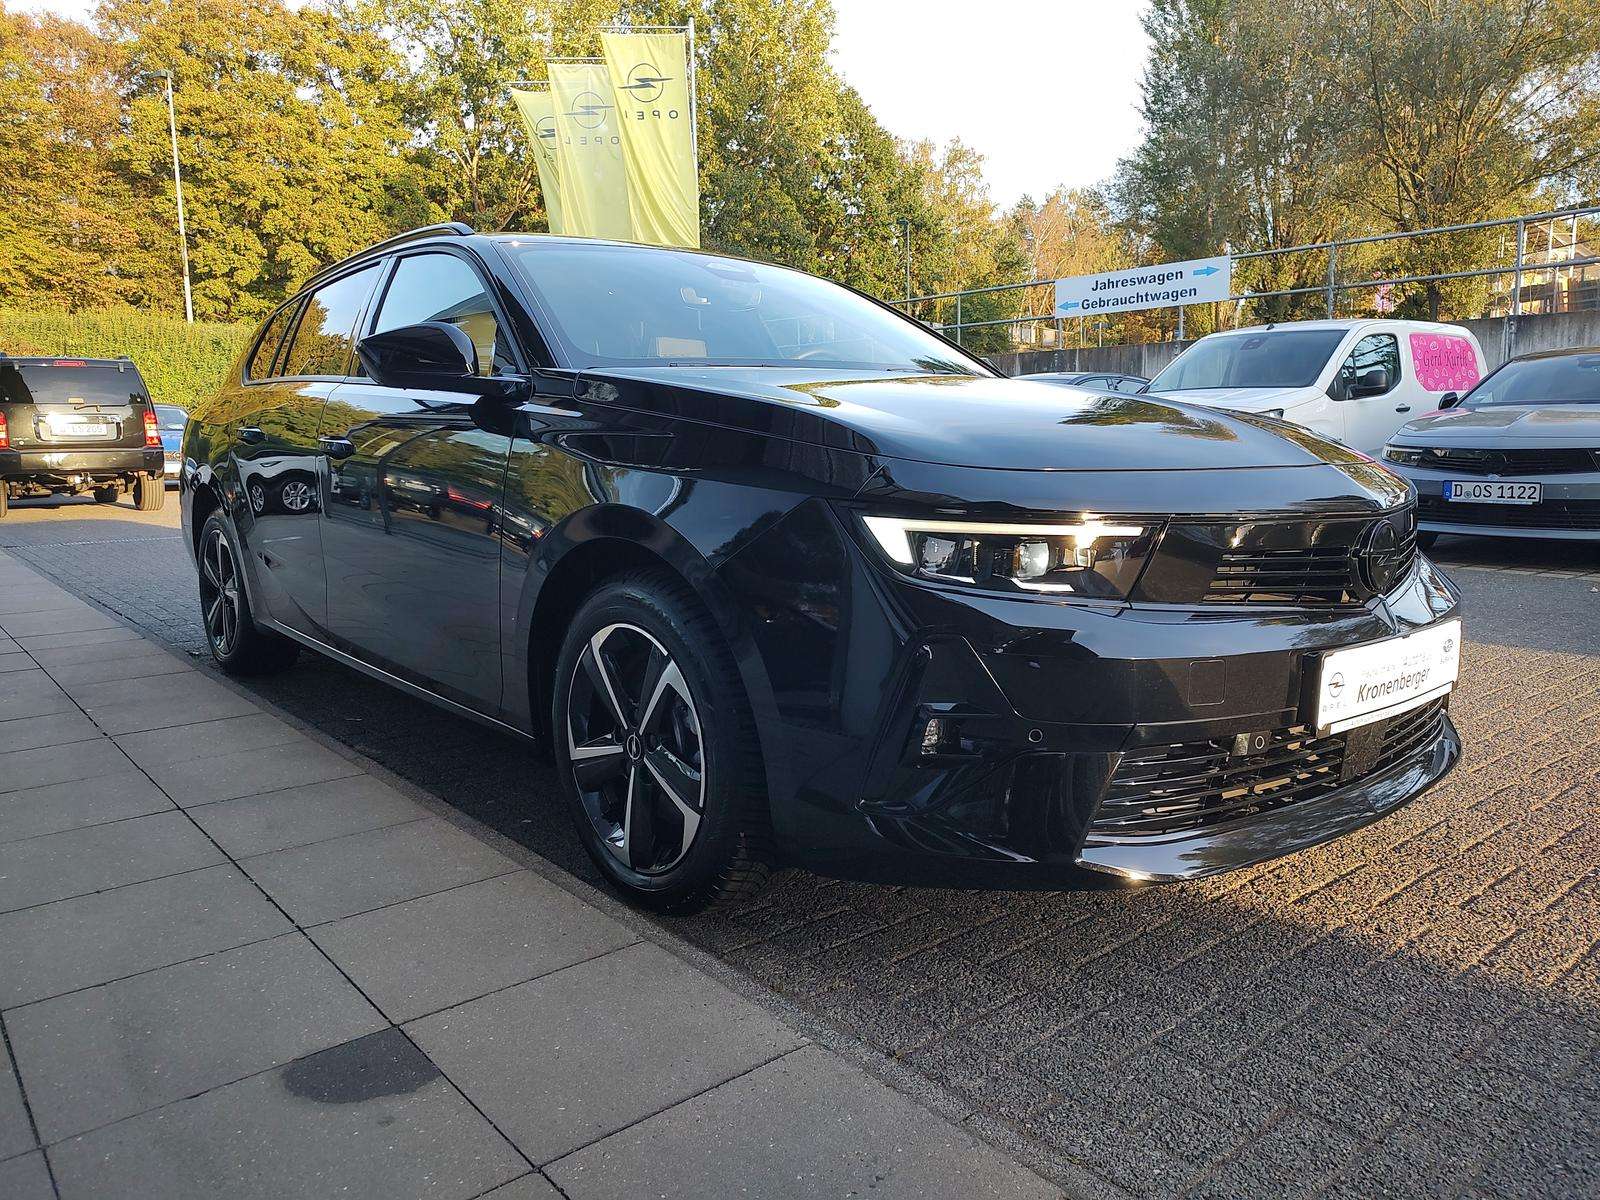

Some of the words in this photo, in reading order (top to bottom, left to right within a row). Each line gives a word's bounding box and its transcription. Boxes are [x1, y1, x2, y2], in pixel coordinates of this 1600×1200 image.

[1091, 270, 1183, 292] Jahreswagen
[1081, 287, 1197, 310] Gebrauchtwagen
[1453, 484, 1463, 498] D
[1472, 484, 1492, 498] OS
[1497, 485, 1537, 500] 1122
[1356, 667, 1431, 704] Kronenberger
